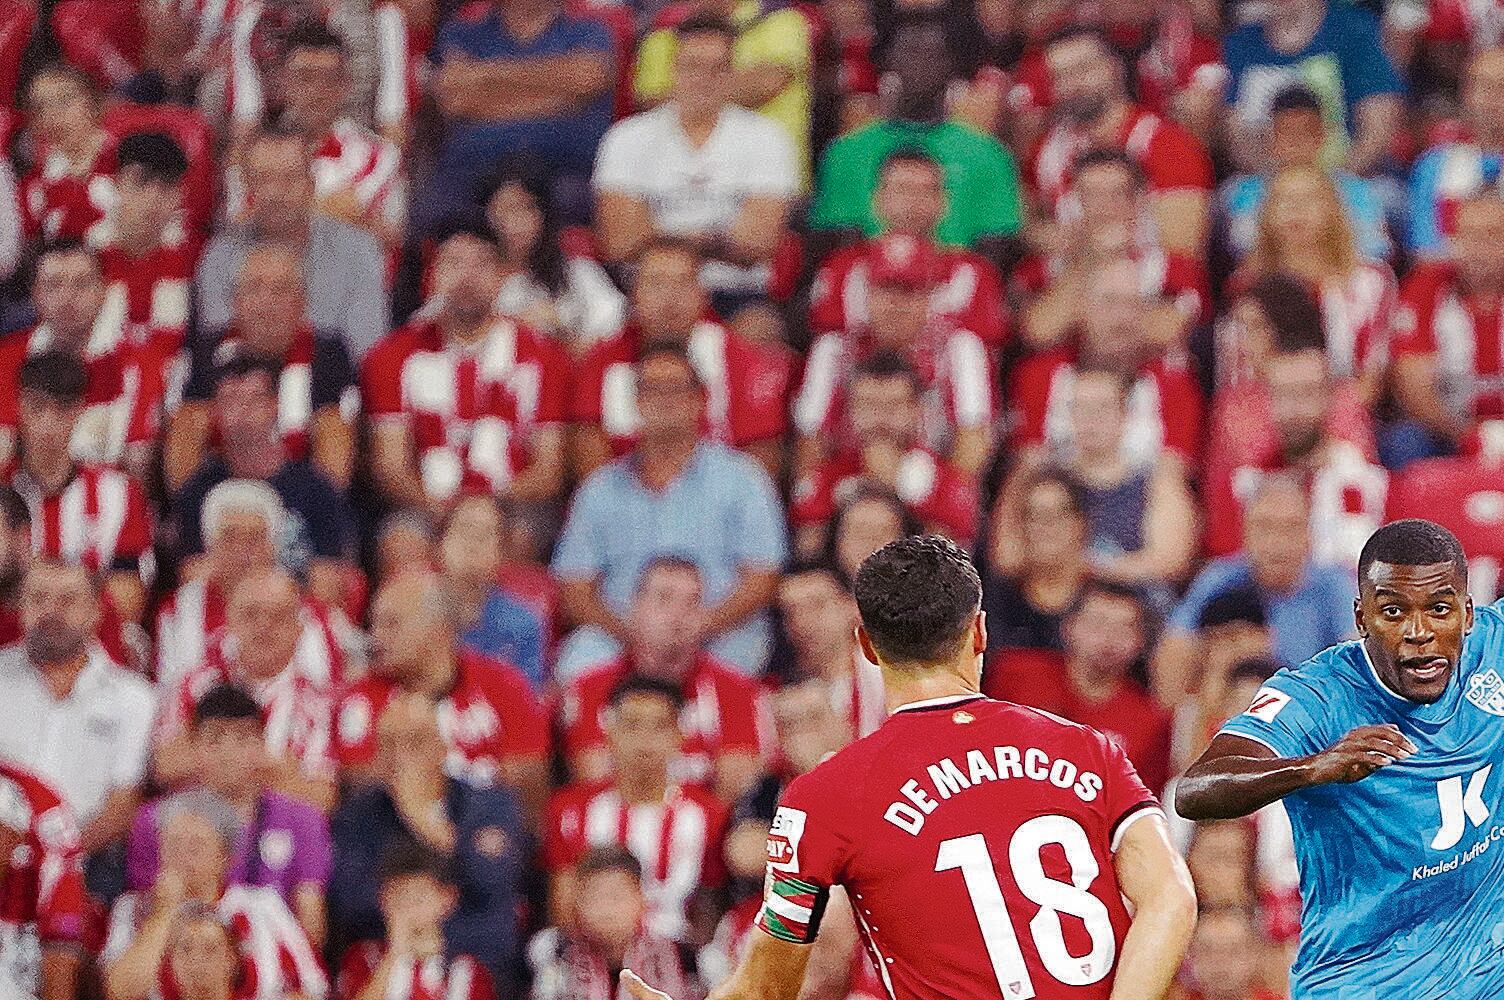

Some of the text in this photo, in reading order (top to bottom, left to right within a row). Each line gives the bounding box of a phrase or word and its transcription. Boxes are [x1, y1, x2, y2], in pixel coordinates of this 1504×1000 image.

[883, 745, 1103, 836] DE MARCOS
[1430, 762, 1493, 851] JK
[1412, 854, 1459, 881] Khaled
